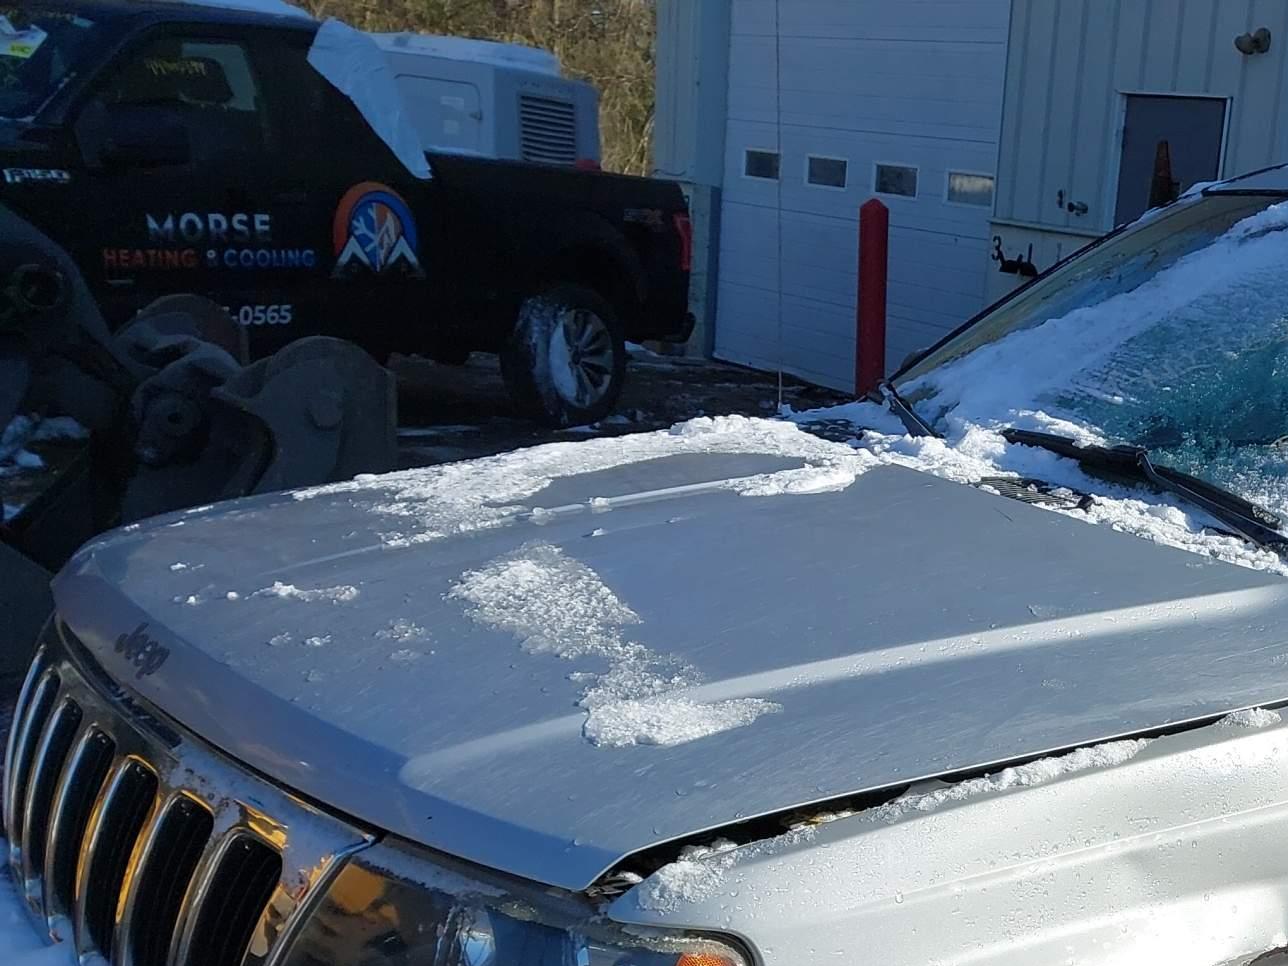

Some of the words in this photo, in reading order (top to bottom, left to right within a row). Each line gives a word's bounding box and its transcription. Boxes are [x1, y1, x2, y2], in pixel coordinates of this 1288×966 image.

[145, 212, 272, 242] MORSE
[102, 248, 198, 268] HEATING
[223, 248, 316, 268] COOLING
